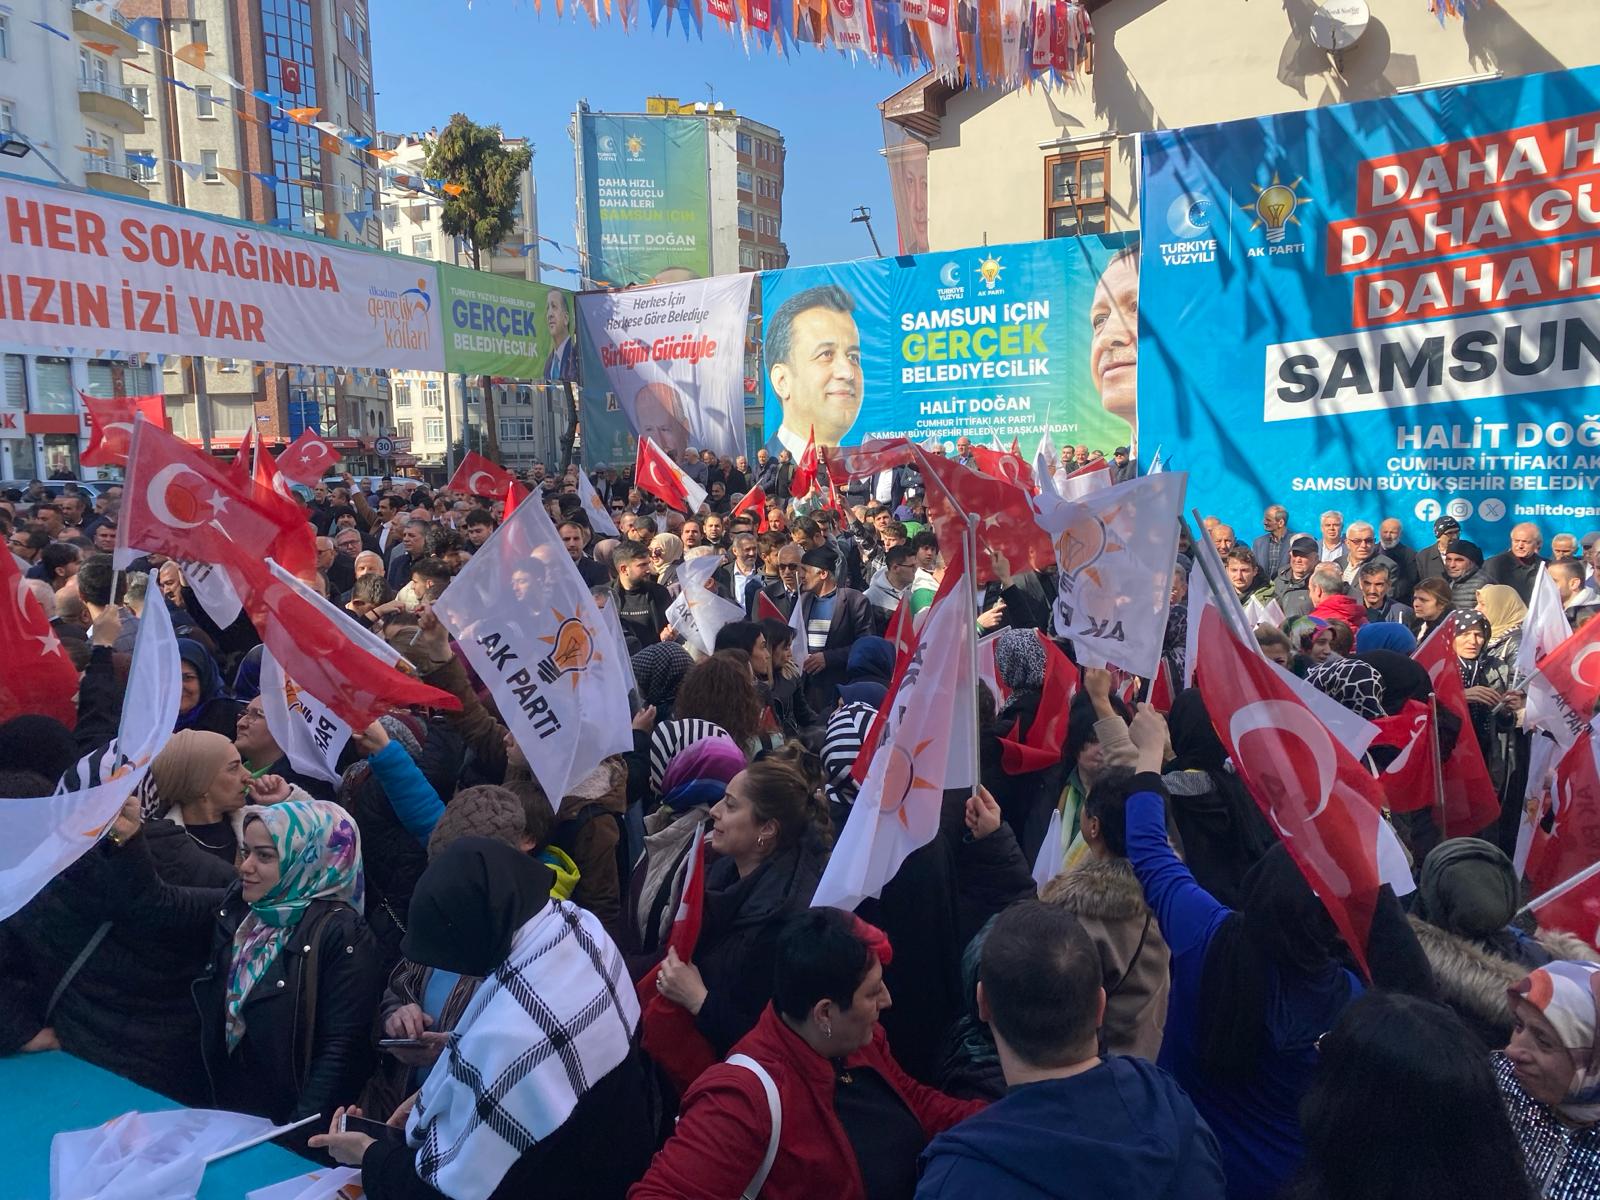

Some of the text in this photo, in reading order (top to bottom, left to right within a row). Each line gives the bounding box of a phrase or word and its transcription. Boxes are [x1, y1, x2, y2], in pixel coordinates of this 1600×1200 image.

[903, 2, 923, 14] MHP
[931, 3, 946, 17] MHP
[839, 32, 861, 44] MHP
[1371, 135, 1548, 208] DAHA
[598, 178, 655, 188] DAHA HIZLI
[599, 188, 628, 198] DAHA
[599, 199, 629, 209] DAHA
[645, 232, 696, 246] DOĞAN
[1341, 200, 1512, 266] DAHA
[6, 196, 340, 293] HER SOKAĞINDA
[1247, 247, 1265, 257] AK
[1367, 256, 1542, 319] DAHA
[0, 273, 266, 343] IZIN İZİ VAR
[633, 292, 686, 310] Herkes İçin
[452, 299, 536, 337] GERÇEK
[606, 307, 709, 330] Herkese Göre Belediye
[901, 305, 996, 331] SAMSUN
[601, 335, 717, 370] Birliğin Gücüyle
[901, 322, 1050, 363] GERÇEK
[1276, 317, 1600, 403] SAMSUN
[920, 394, 1031, 415] HALİT DOĞAN
[916, 418, 954, 428] CUMHUR
[955, 415, 991, 426] İTTİFAKI
[993, 415, 1007, 425] AK
[963, 426, 1006, 437] BELEDİYE
[1007, 424, 1046, 435] BAŞKAN
[1048, 422, 1078, 433] ADAYI
[1397, 414, 1600, 450] HALİT DOĞ
[378, 442, 394, 451] 30
[1387, 451, 1600, 471] CUMHUR İTTİFAKI AK
[1292, 476, 1373, 491] SAMSUN
[1376, 472, 1505, 494] BÜYÜKŞEHİR
[477, 632, 518, 672] AK
[1551, 693, 1567, 712] AK
